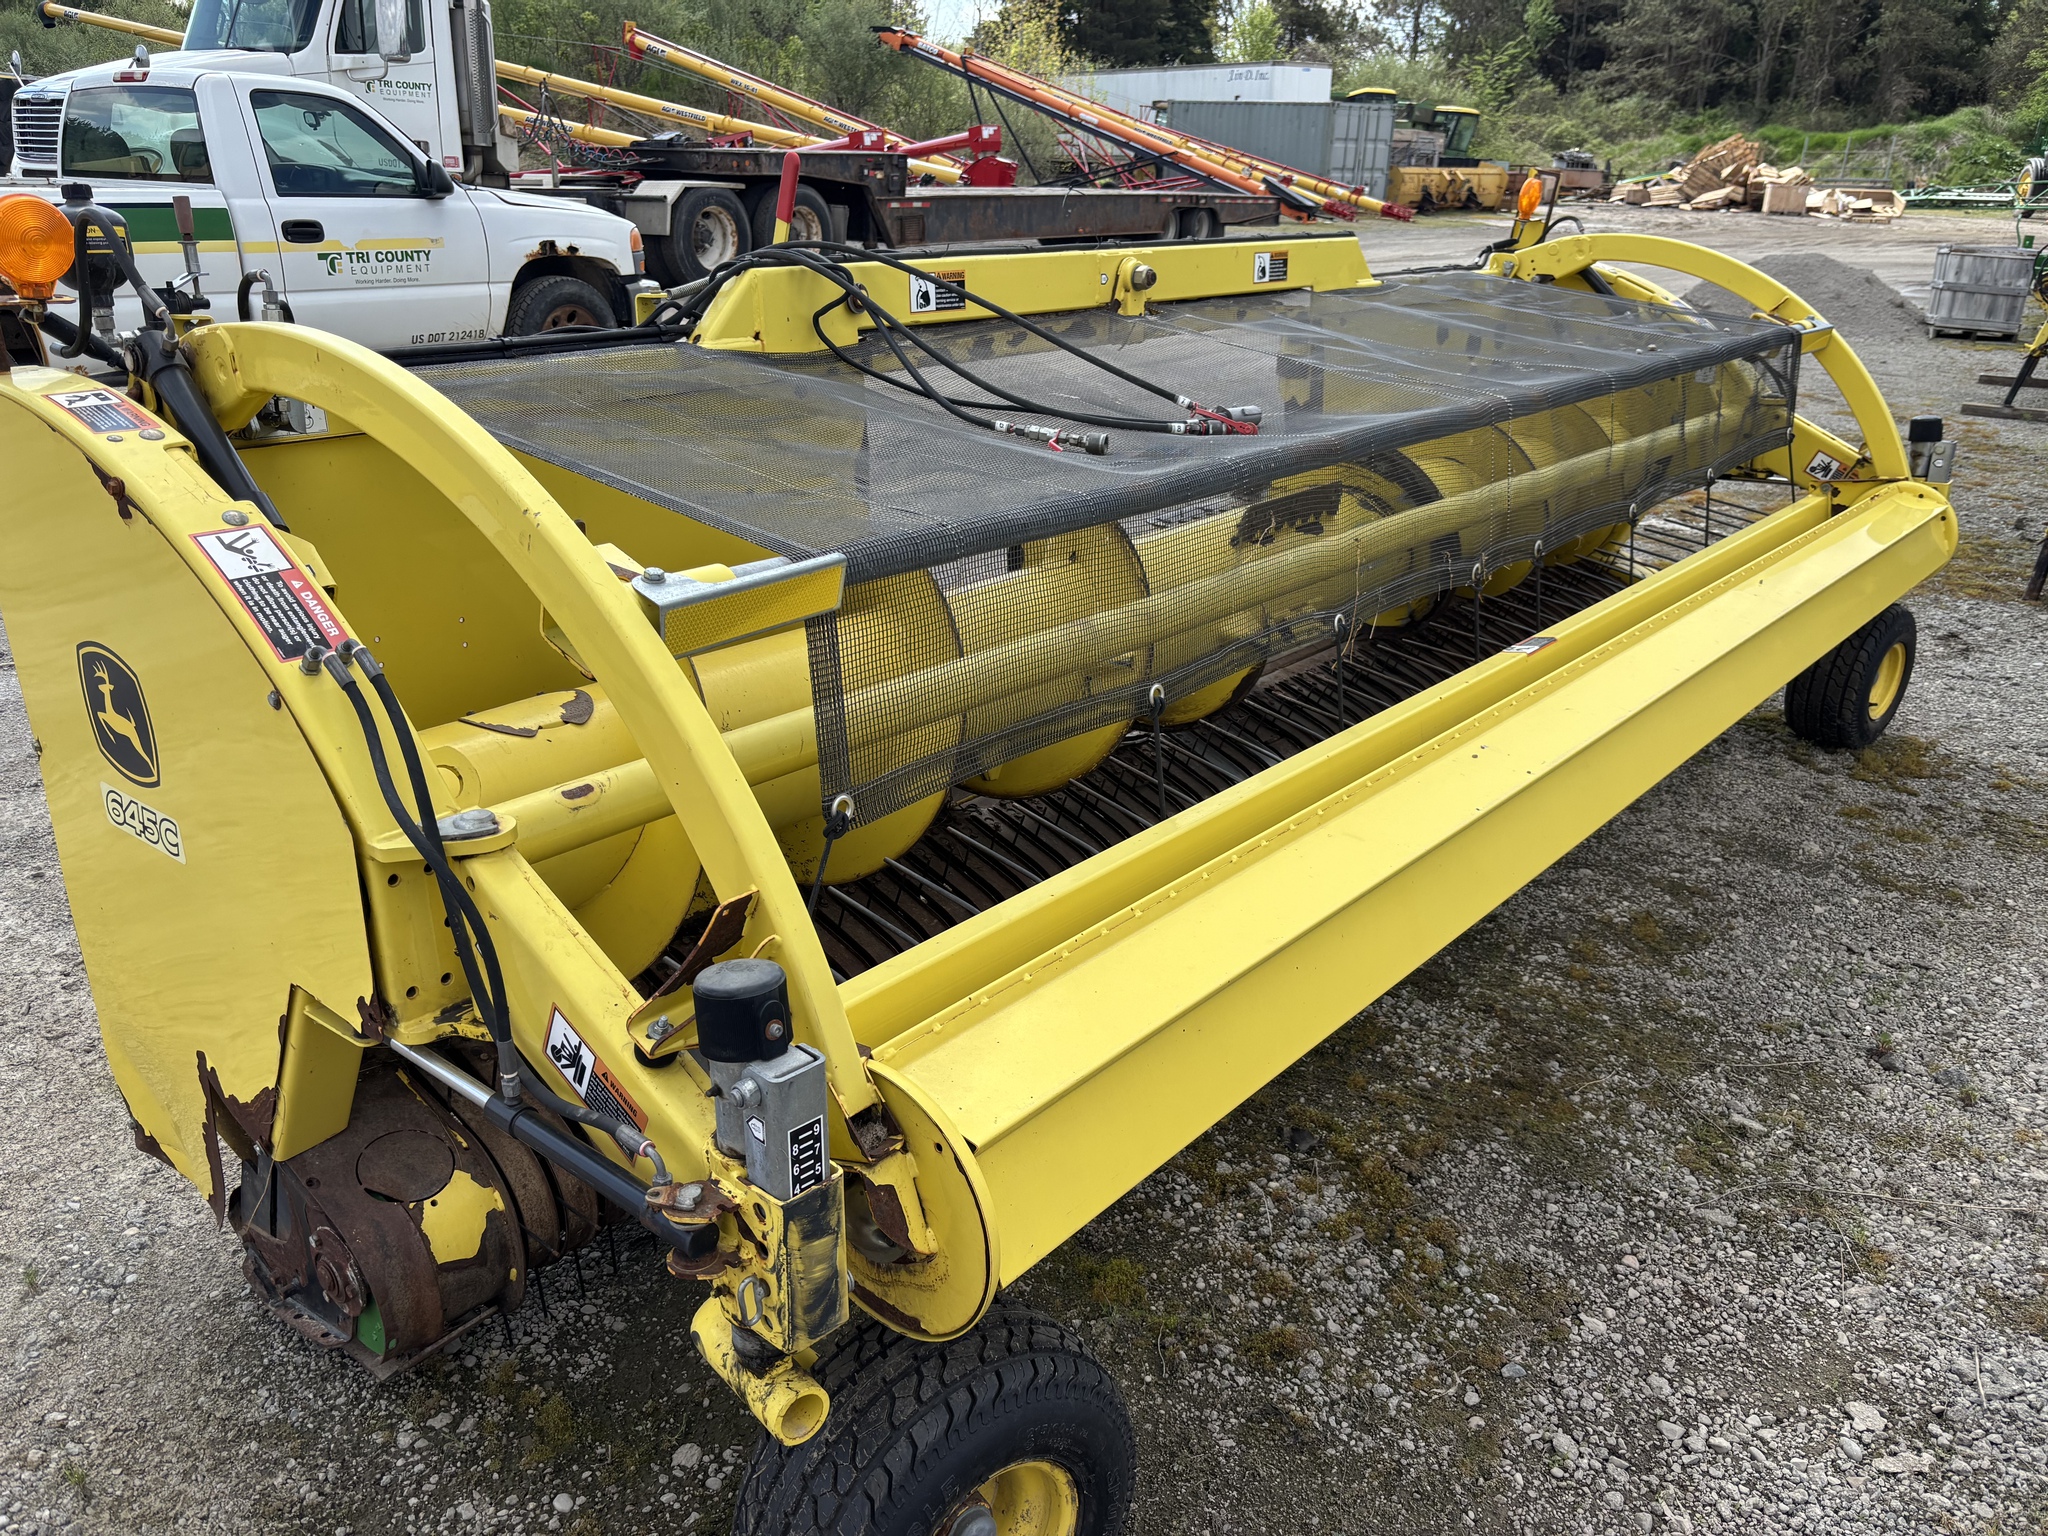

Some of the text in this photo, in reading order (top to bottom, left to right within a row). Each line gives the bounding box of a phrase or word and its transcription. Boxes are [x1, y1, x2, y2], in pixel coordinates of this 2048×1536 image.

[379, 80, 432, 91] TRI COUNTY
[380, 89, 431, 98] EQUIPMENT
[676, 110, 706, 121] WESTFIELD
[345, 249, 431, 264] TRI COUNTY
[350, 263, 430, 276] EQUIPMENT
[941, 271, 965, 280] WARNING
[411, 329, 485, 345] US DOT 212418
[266, 581, 281, 597] death
[278, 597, 290, 611] from
[233, 580, 248, 596] when
[251, 605, 260, 613] in
[256, 612, 273, 634] motion.
[242, 578, 261, 601] clothing
[263, 606, 272, 615] be
[269, 615, 282, 628] near
[278, 628, 294, 645] auger
[251, 576, 260, 585] do
[257, 584, 269, 595] not
[264, 594, 279, 609] allow
[274, 609, 298, 636] person(s)
[276, 580, 321, 639] To avoid serious injury
[300, 591, 340, 637] DANGER
[105, 789, 180, 857] 645C
[609, 1080, 638, 1118] WARNING
[813, 1123, 820, 1136] 9
[792, 1142, 821, 1156] 8 7
[793, 1162, 822, 1176] 6 5
[794, 1183, 801, 1195] 4
